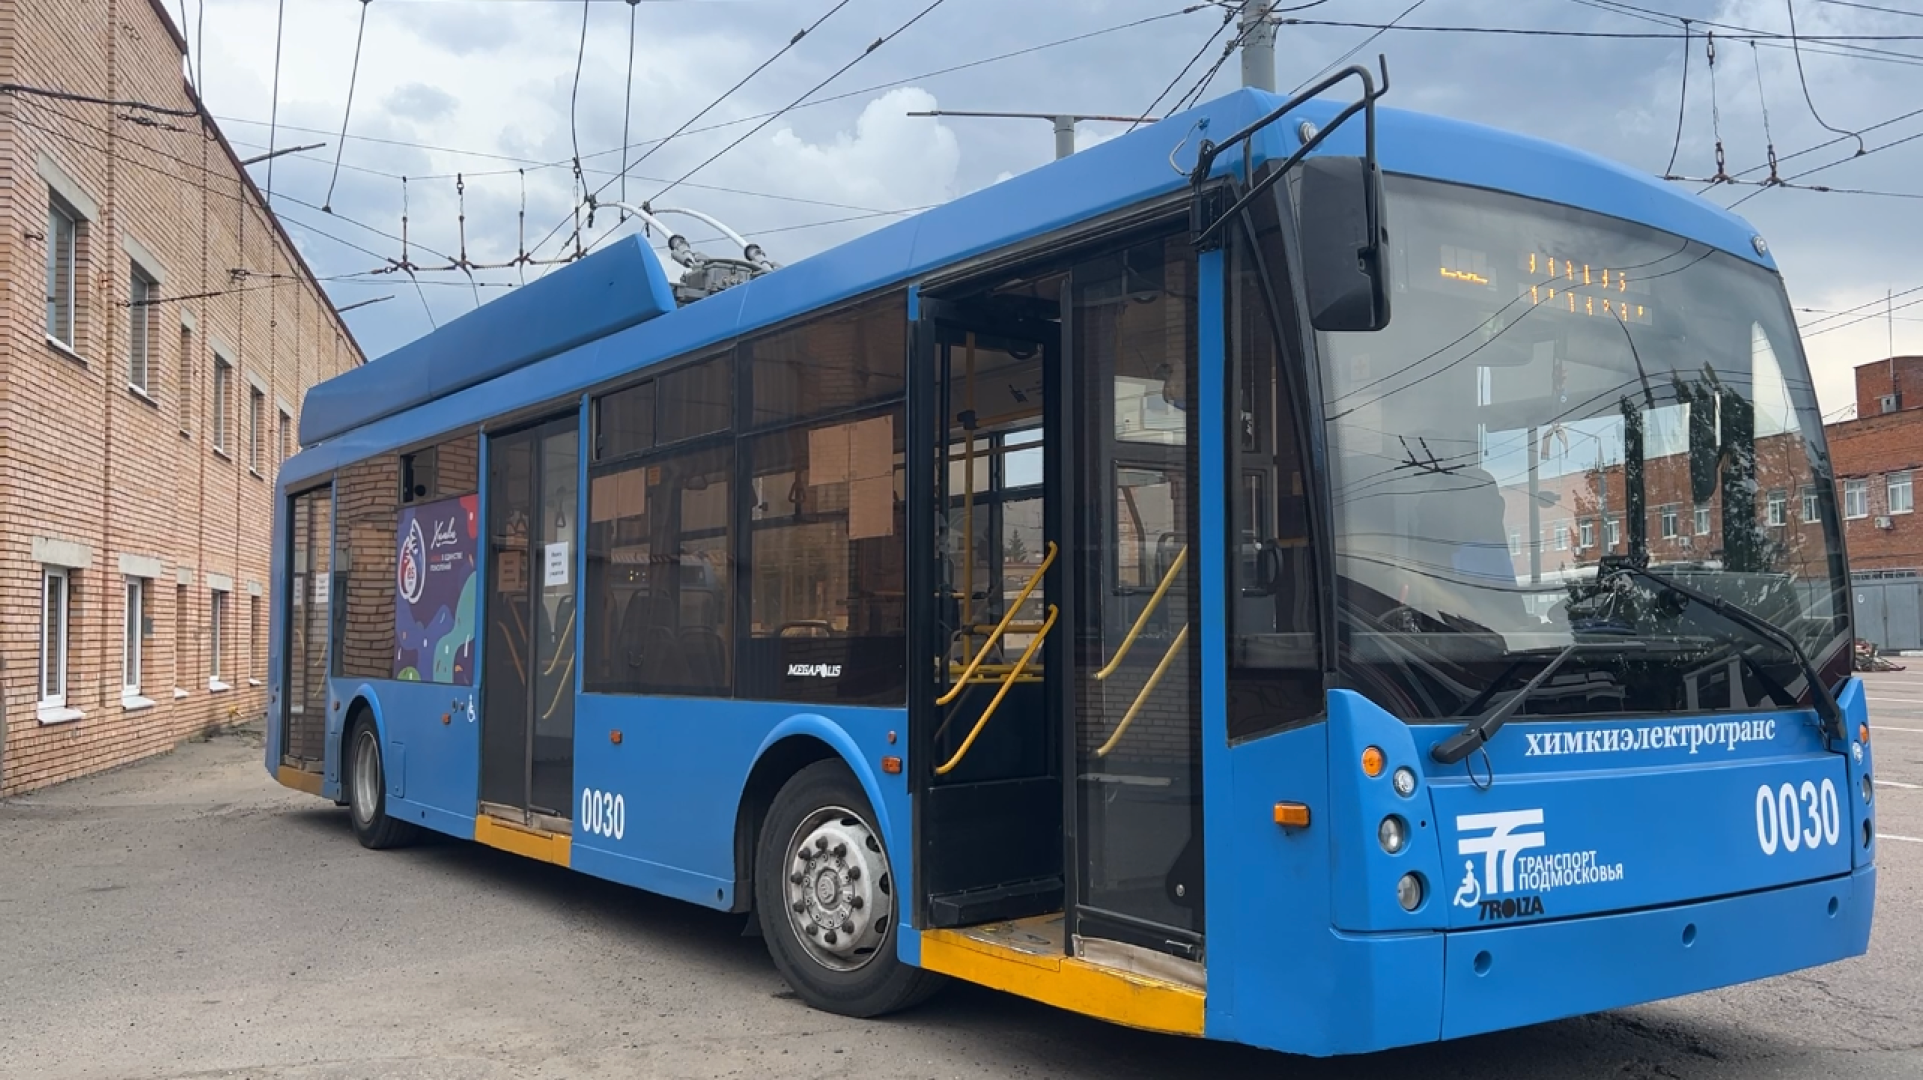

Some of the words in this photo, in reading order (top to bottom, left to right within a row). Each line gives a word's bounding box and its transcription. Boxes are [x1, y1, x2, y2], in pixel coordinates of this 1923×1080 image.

[1524, 719, 1776, 755] химкиэлектротранс
[581, 787, 626, 840] 0030
[1756, 777, 1840, 856] 0030
[1518, 850, 1598, 874] ТРАНСПОРТ
[1519, 862, 1625, 893] ПОДМОСКОВЬЯ
